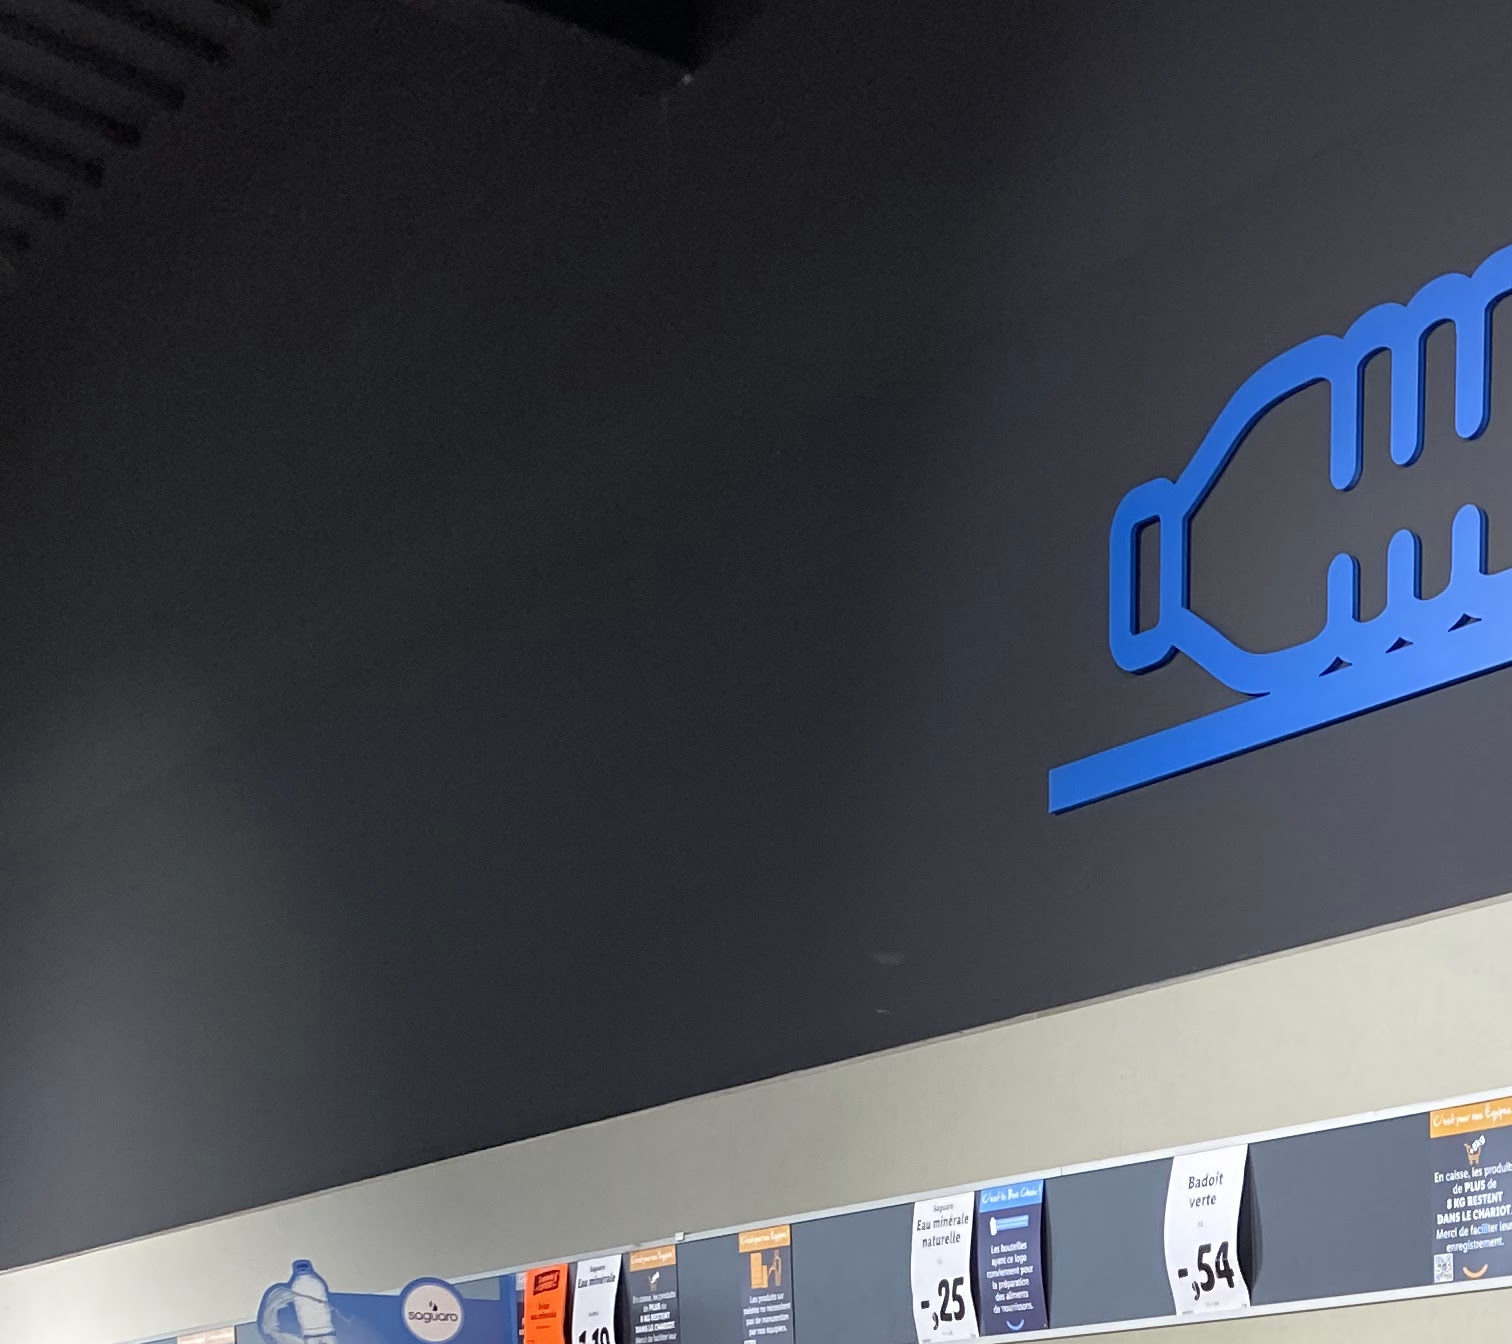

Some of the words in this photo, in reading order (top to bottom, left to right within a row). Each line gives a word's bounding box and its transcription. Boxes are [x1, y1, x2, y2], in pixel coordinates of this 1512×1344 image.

[1188, 1171, 1224, 1190] Badoit
[1434, 1172, 1444, 1183] En
[1471, 1166, 1482, 1177] les
[1453, 1184, 1462, 1194] de
[1464, 1180, 1485, 1192] PLUS
[1487, 1178, 1497, 1189] de
[1189, 1194, 1217, 1209] verte
[1453, 1197, 1466, 1208] KG
[1467, 1191, 1503, 1206] RESTENT
[917, 1219, 931, 1231] Eau
[933, 1213, 969, 1229] minérale
[1437, 1212, 1460, 1224] DANS
[1462, 1210, 1471, 1221] LE
[1473, 1204, 1512, 1220] CHARIOT.
[922, 1231, 960, 1248] naturelle
[1436, 1228, 1457, 1239] Merci
[1459, 1226, 1469, 1237] de
[1177, 1240, 1235, 1301] -,54
[921, 1276, 965, 1330] -,25
[408, 1311, 458, 1323] saguaro
